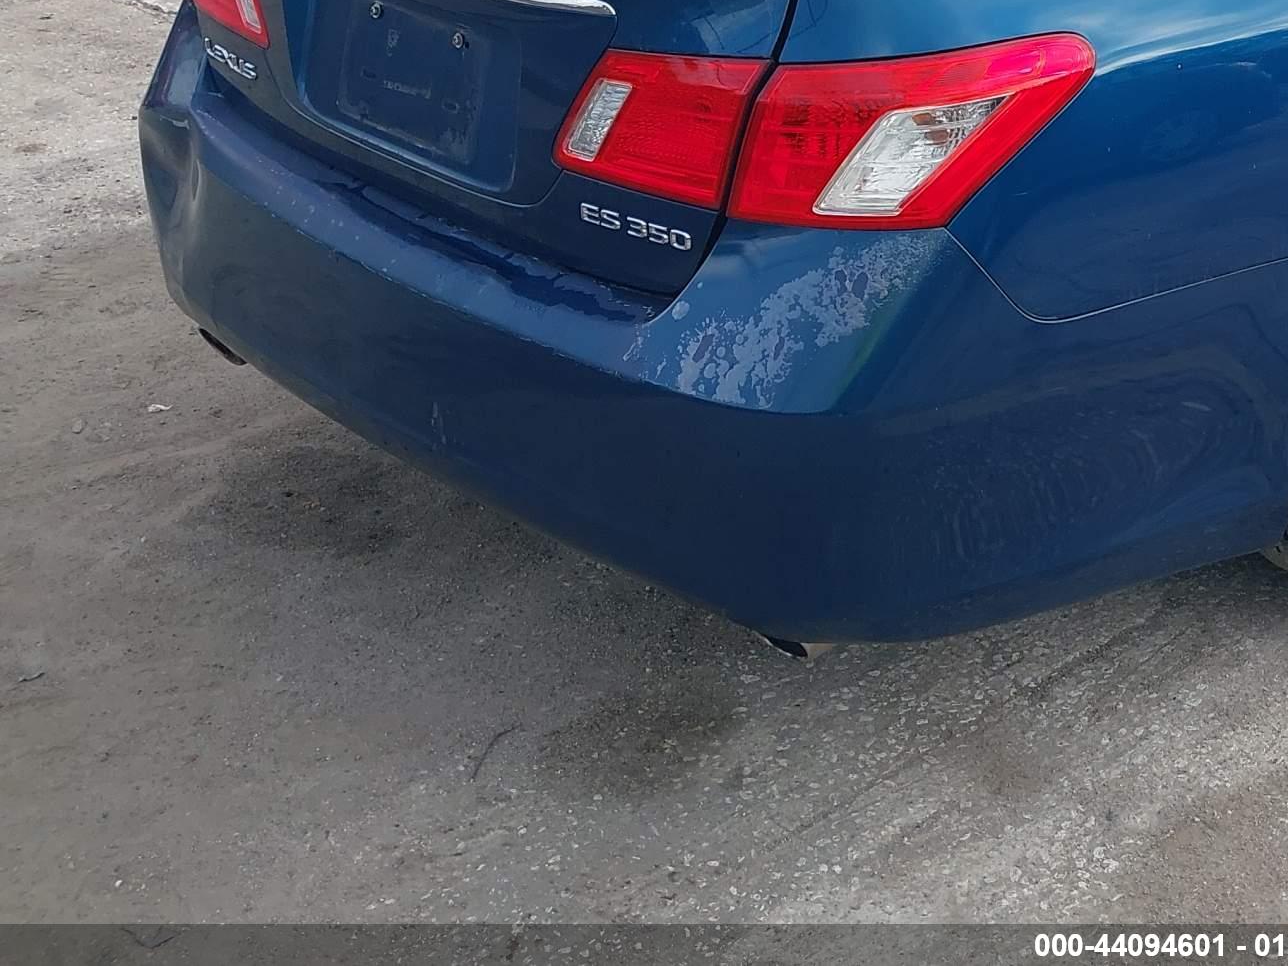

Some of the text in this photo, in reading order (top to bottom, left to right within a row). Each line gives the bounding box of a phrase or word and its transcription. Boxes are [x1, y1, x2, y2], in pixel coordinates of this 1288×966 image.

[204, 37, 257, 80] LEXUS
[580, 202, 692, 251] ES 350
